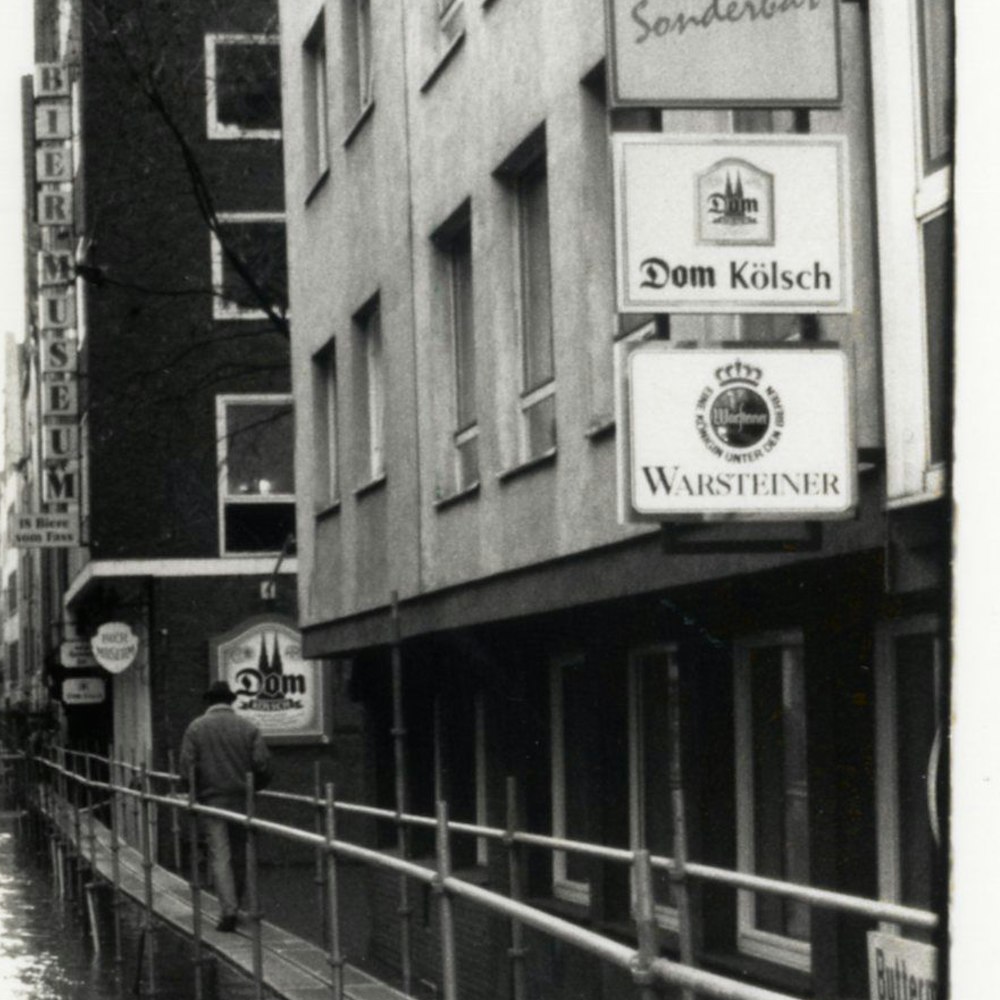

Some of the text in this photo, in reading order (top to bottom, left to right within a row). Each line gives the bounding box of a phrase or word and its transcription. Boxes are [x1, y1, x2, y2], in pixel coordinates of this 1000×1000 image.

[639, 257, 832, 291] Dom Kölsch
[641, 465, 841, 497] WARSTEINER
[235, 668, 306, 696] Dom
